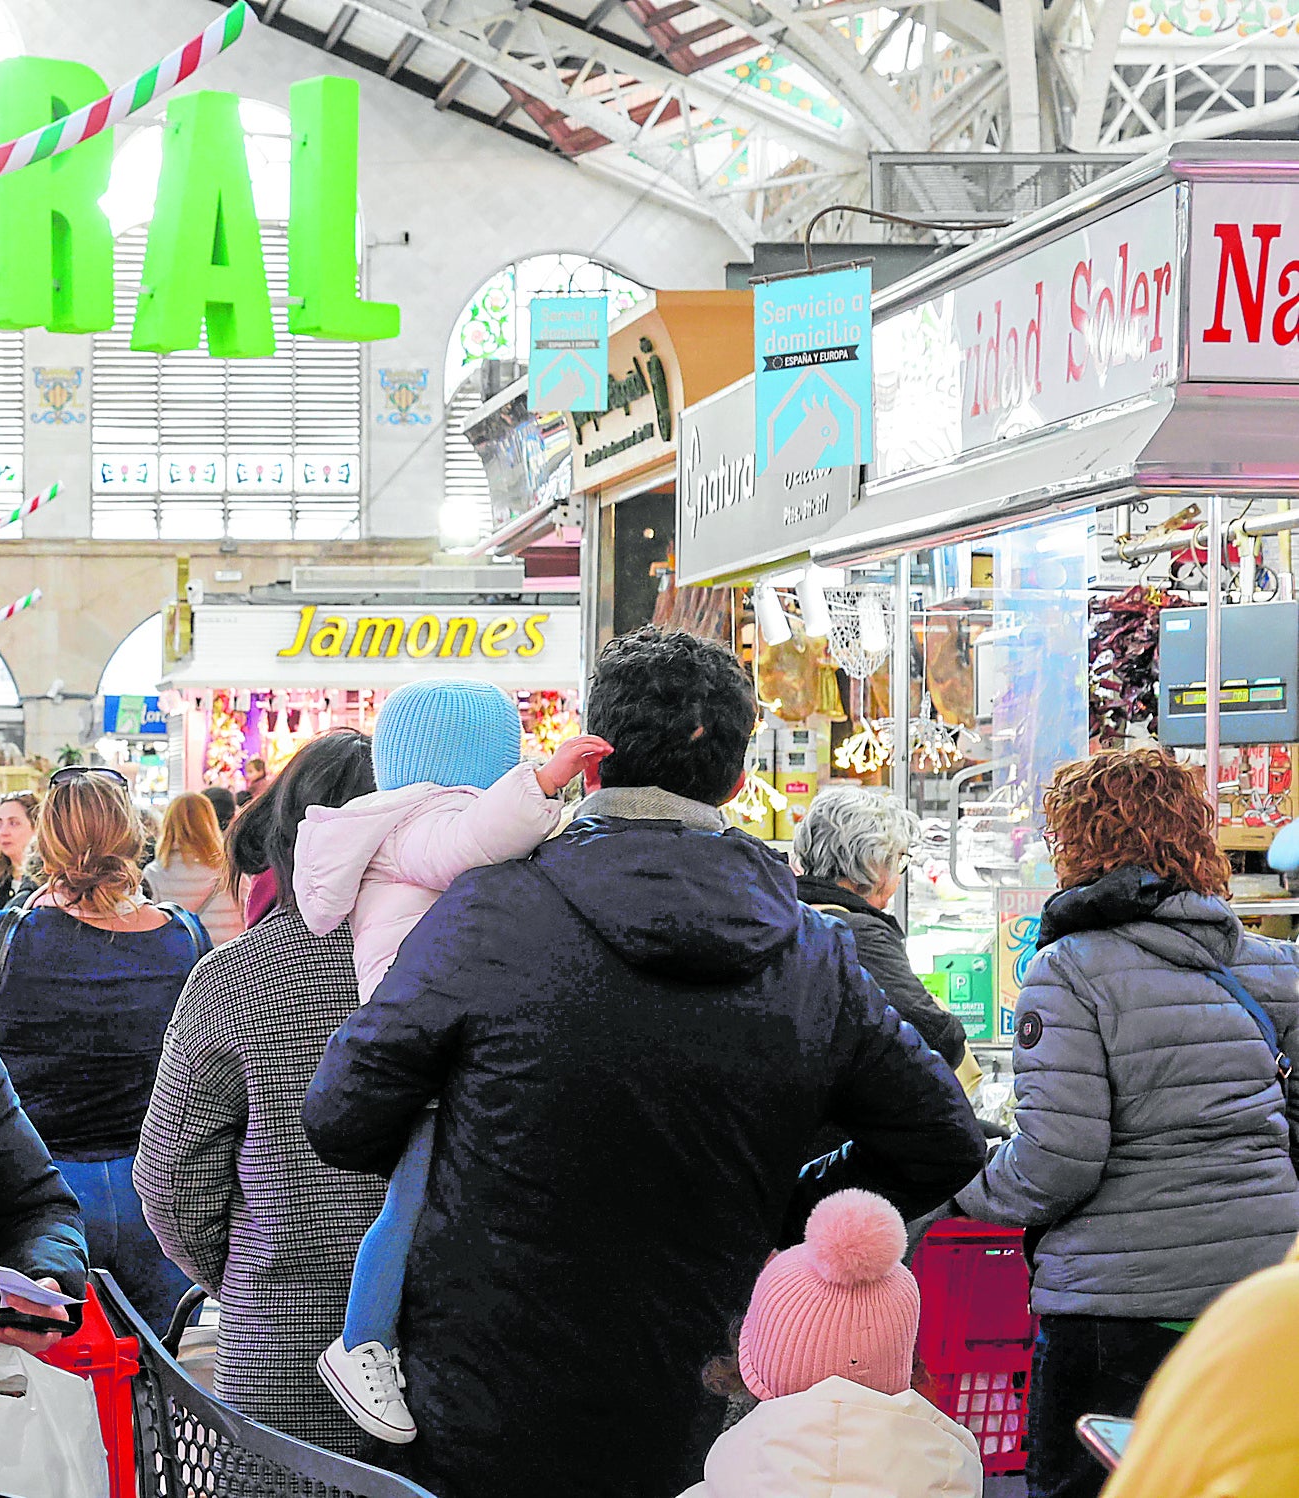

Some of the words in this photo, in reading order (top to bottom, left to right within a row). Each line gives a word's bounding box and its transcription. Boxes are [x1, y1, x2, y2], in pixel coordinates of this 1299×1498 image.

[762, 292, 845, 325] Servicio
[852, 294, 864, 312] a
[1066, 242, 1171, 383] Soler
[765, 320, 861, 353] domicilio
[784, 353, 813, 367] ESPAÑA
[813, 353, 819, 363] Y
[819, 349, 849, 362] EUROPA
[278, 605, 550, 658] Jamones
